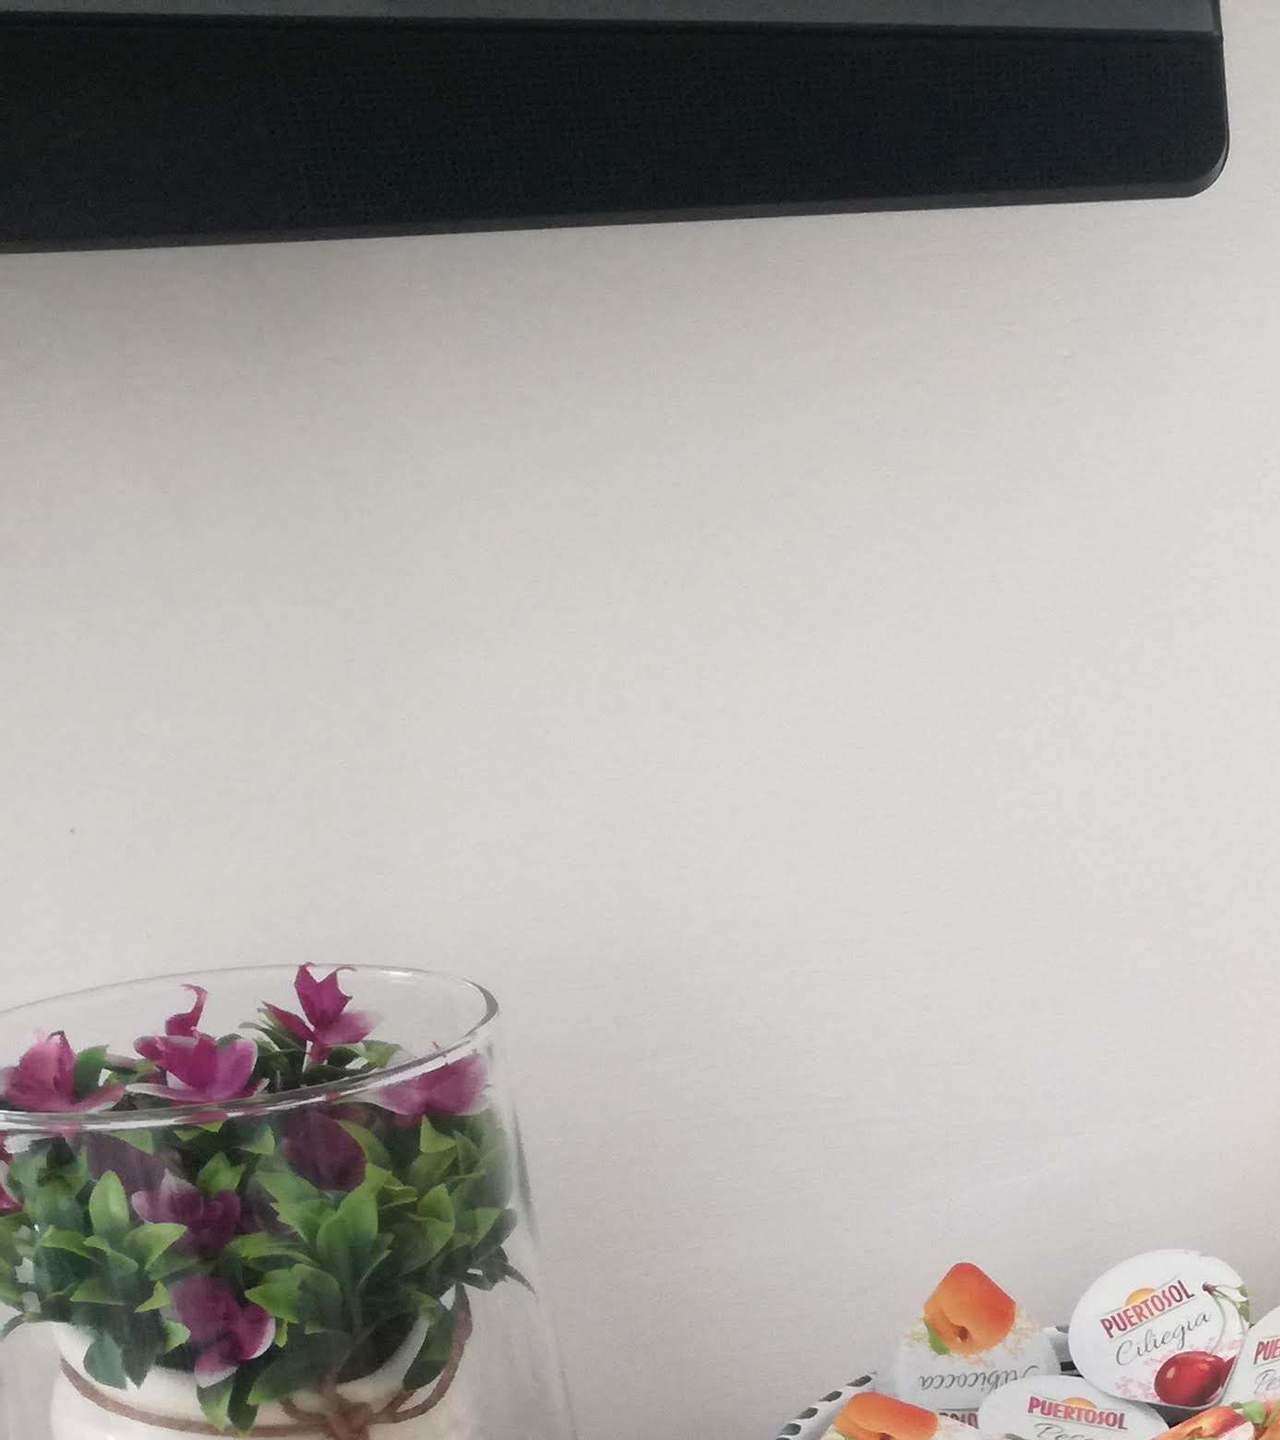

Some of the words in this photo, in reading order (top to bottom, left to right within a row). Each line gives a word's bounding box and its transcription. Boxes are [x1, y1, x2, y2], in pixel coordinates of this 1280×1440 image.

[1099, 1278, 1196, 1339] PUERTOSOL
[1115, 1310, 1210, 1366] Ciliegia
[1027, 1395, 1128, 1430] PUERTOSOL
